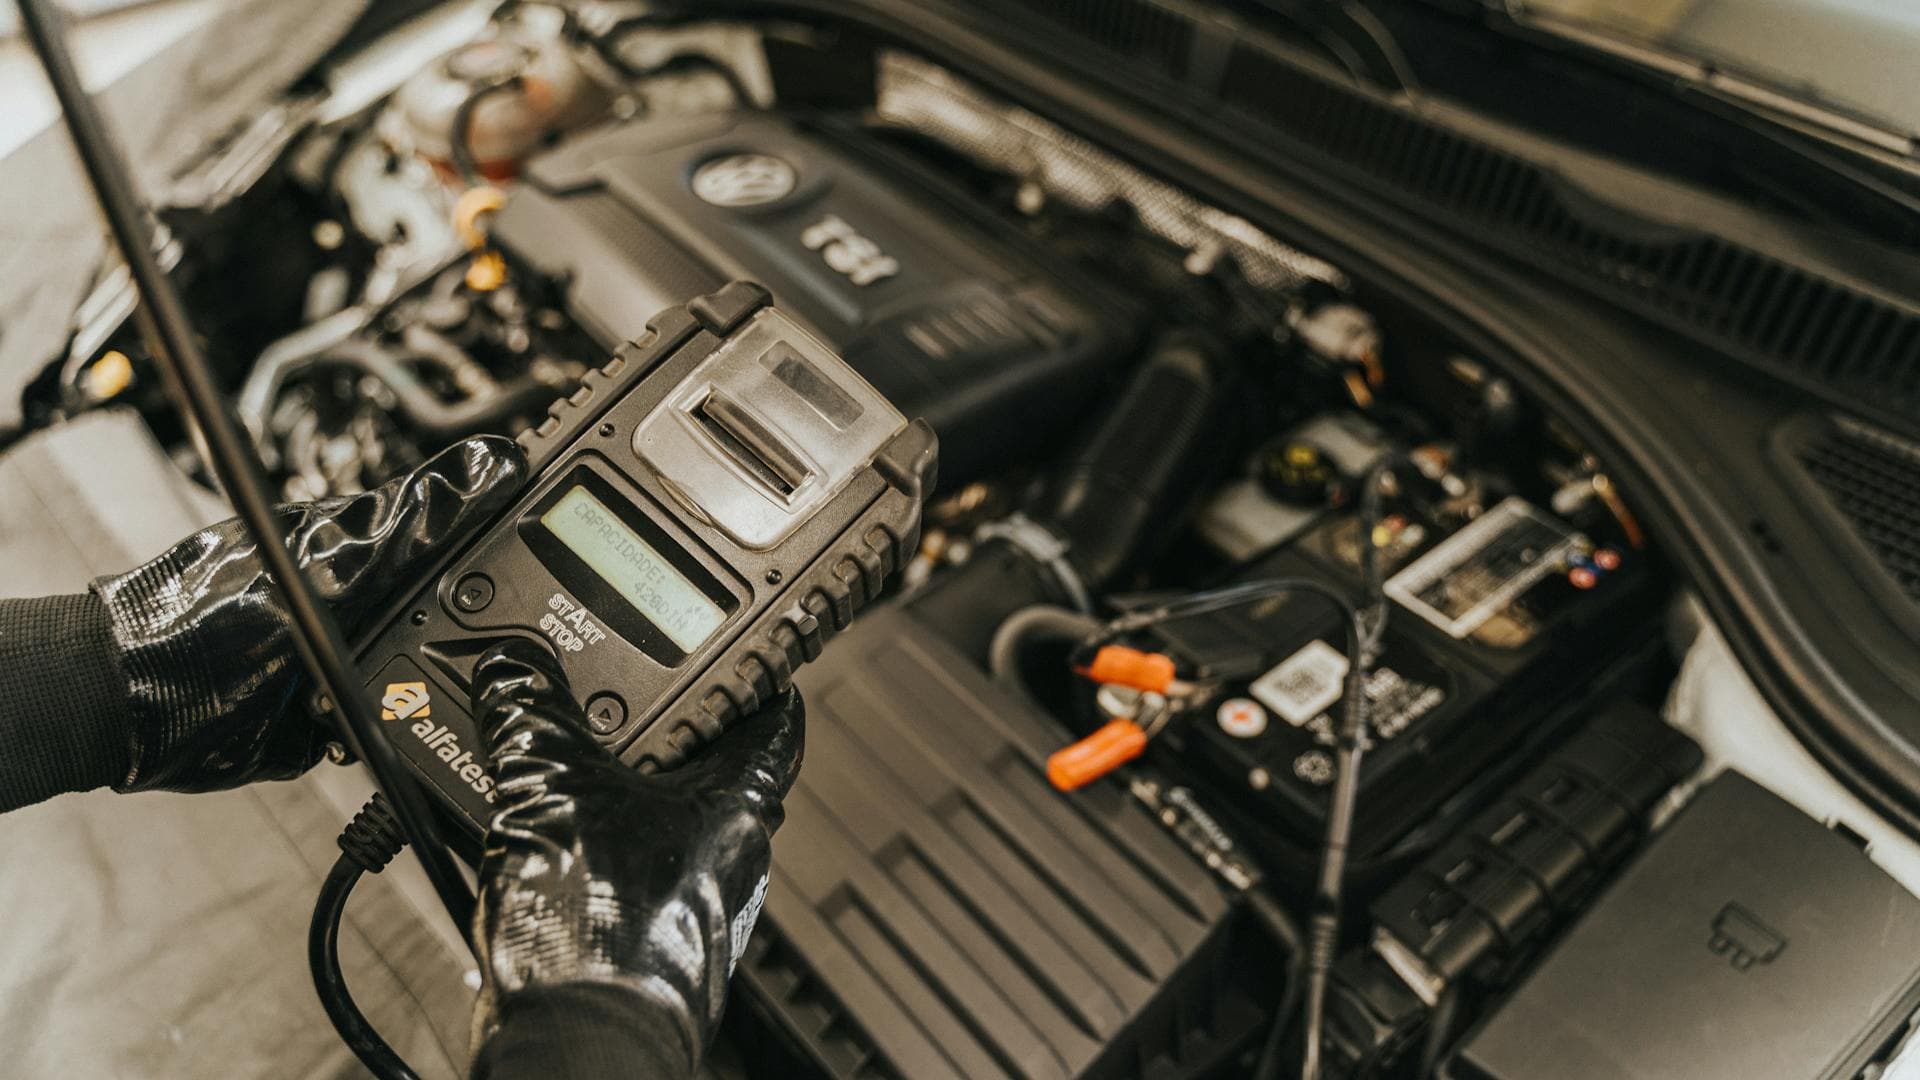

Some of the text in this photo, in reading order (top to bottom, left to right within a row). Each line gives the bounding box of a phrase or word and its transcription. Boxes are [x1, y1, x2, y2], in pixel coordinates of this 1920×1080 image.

[574, 502, 666, 585] CAPACIDADE:
[540, 613, 584, 652] STOP
[549, 593, 606, 645] START
